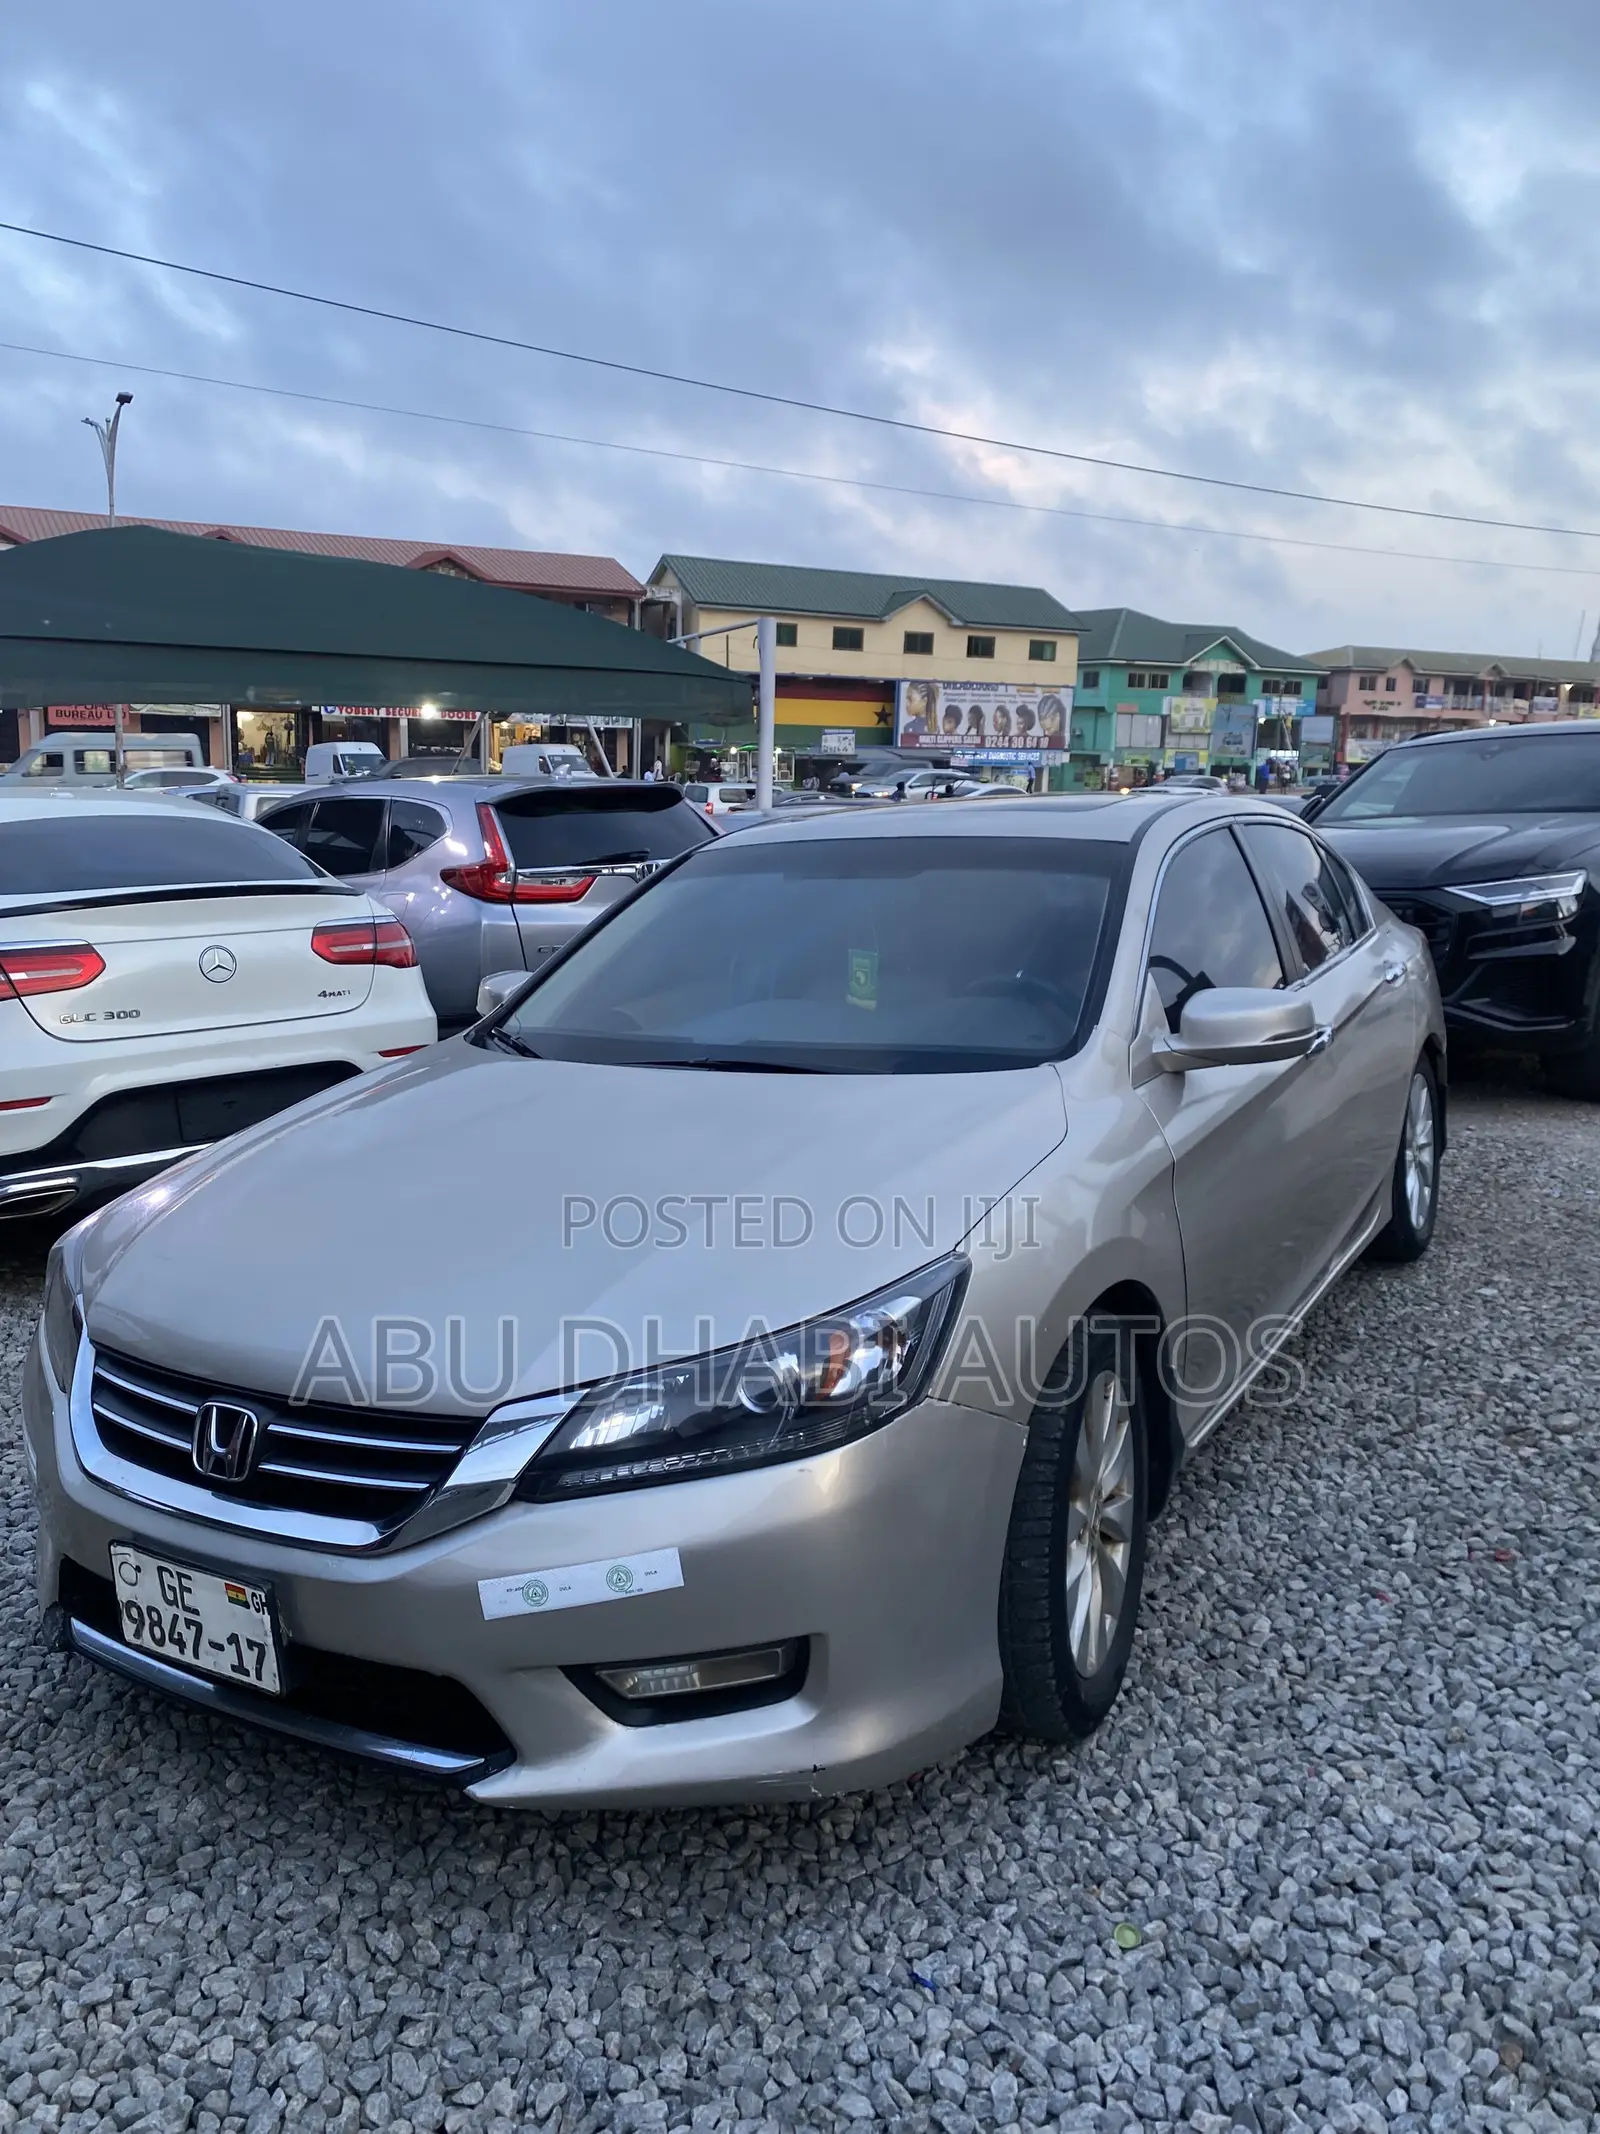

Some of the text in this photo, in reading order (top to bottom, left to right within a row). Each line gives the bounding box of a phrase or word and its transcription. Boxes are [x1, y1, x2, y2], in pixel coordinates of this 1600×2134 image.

[55, 709, 103, 720] BUREAU
[441, 711, 477, 720] DOORS
[1012, 736, 1024, 748] 30
[60, 1009, 141, 1024] GLC 300
[157, 1565, 200, 1616] GE
[125, 1600, 266, 1682] 9847-17
